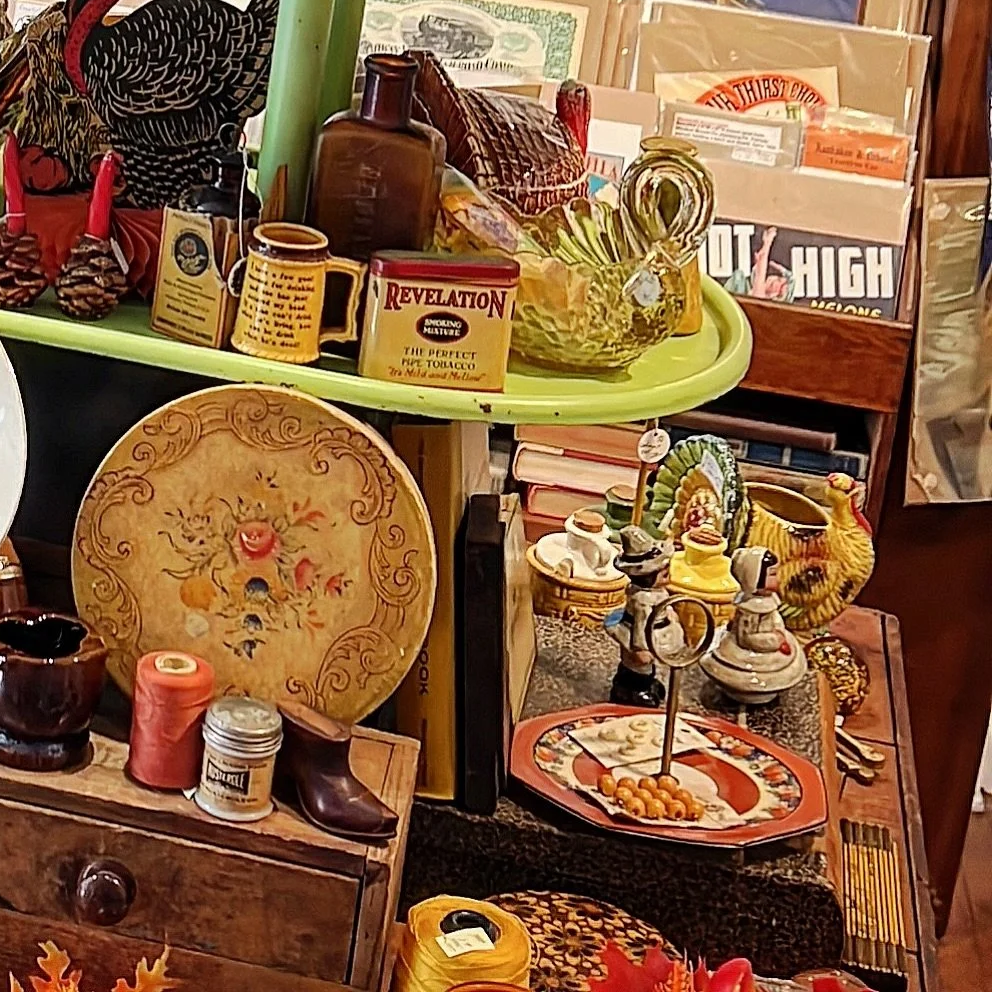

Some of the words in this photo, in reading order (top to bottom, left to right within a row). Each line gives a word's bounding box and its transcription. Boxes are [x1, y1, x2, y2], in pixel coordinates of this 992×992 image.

[732, 76, 788, 106] THIRST
[280, 273, 294, 281] few
[791, 246, 895, 299] HIGH
[271, 281, 283, 289] for
[383, 281, 508, 320] REVELATION
[296, 312, 311, 320] drink
[423, 318, 462, 329] SMOKING
[422, 327, 461, 337] MIXTURE
[403, 346, 423, 357] THE
[428, 347, 477, 360] PERFECT
[401, 358, 423, 367] PIPE
[426, 359, 476, 370] TOBACCO
[405, 368, 427, 378] Mild
[428, 370, 446, 379] and
